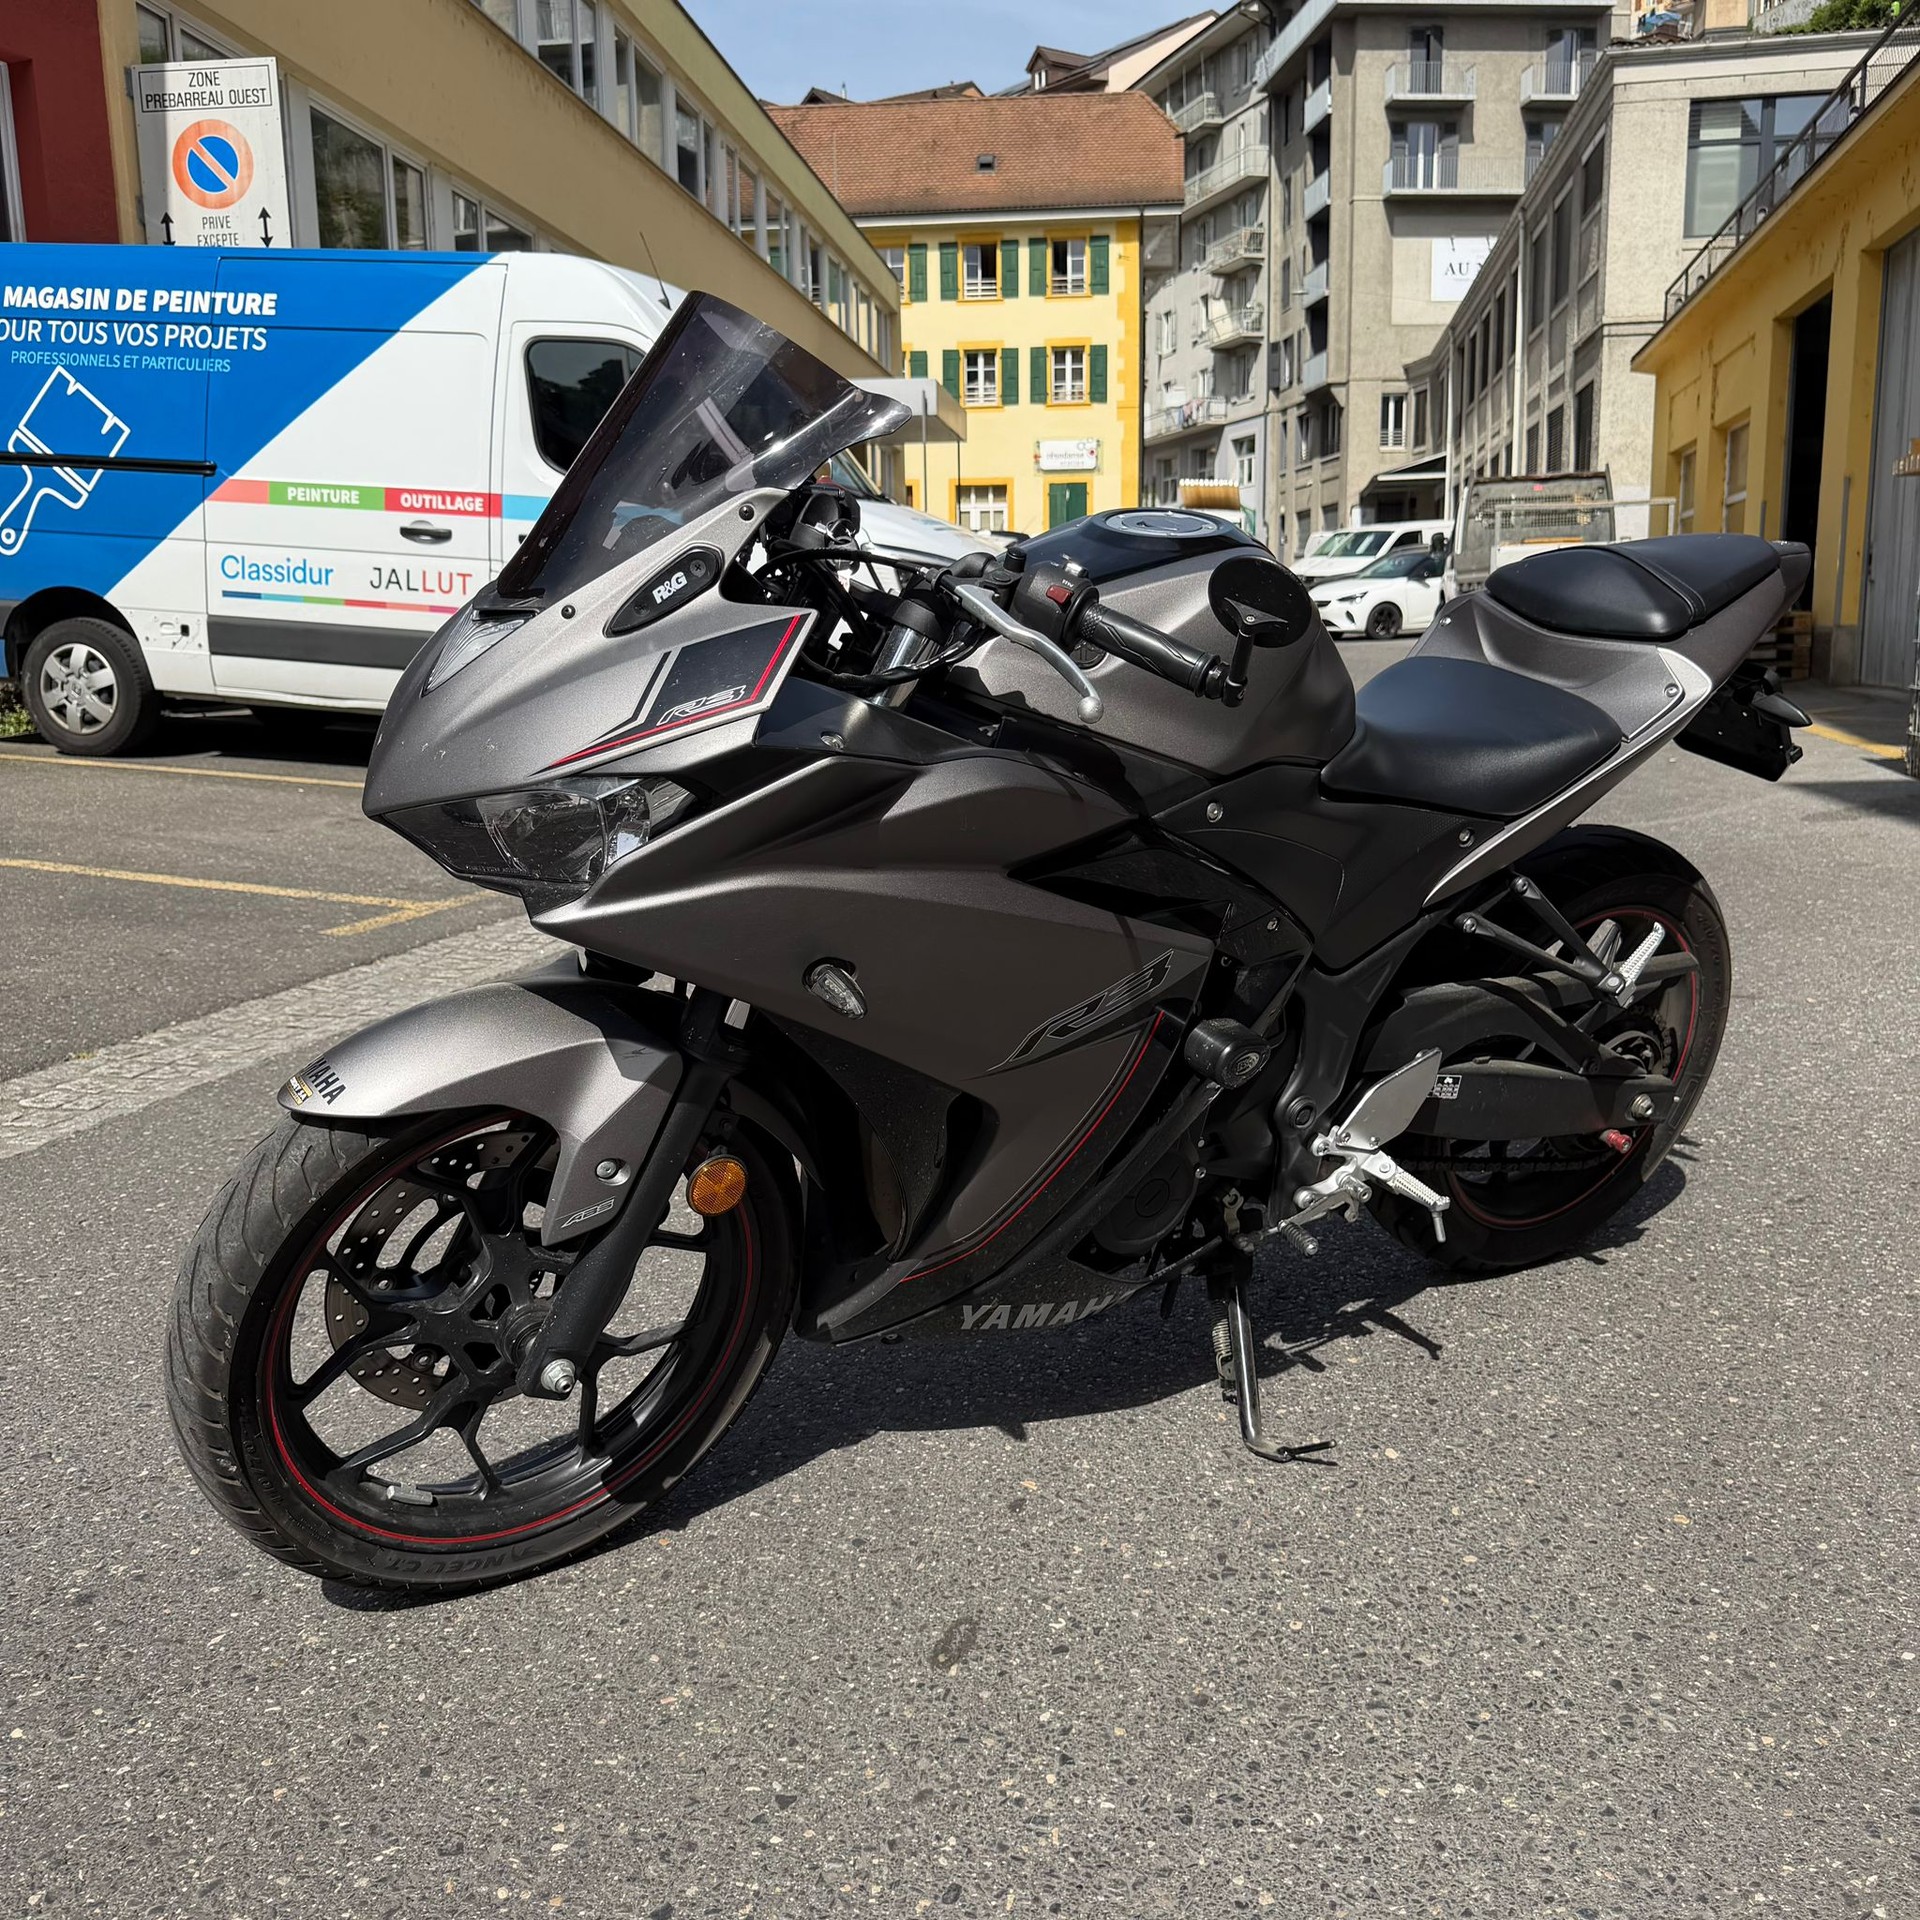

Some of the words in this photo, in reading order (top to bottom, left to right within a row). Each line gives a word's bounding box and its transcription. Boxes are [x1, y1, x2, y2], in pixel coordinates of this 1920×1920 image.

[188, 71, 221, 87] ZONE
[145, 90, 224, 109] PREBARREAU
[228, 88, 267, 105] OUEST
[202, 215, 231, 229] PRIVE
[197, 233, 239, 247] EXCEPTE
[1444, 262, 1469, 276] AU
[3, 285, 111, 310] MAGASIN
[115, 288, 148, 312] DE
[152, 289, 278, 316] PEINTURE
[0, 318, 42, 343] OUR
[47, 320, 109, 345] TOUS
[112, 322, 159, 347] VOS
[164, 324, 268, 351] PROJETS
[10, 350, 121, 368] PROFESSIONNELS
[123, 355, 139, 369] ET
[142, 355, 231, 373] PARTICULIERS
[287, 486, 360, 505] PEINTURE
[400, 493, 484, 512] OUTILLAGE
[220, 554, 334, 586] Classidur
[370, 567, 472, 595] JALLUT
[652, 572, 687, 604] R&G
[961, 1294, 1114, 1329] YAMAH
